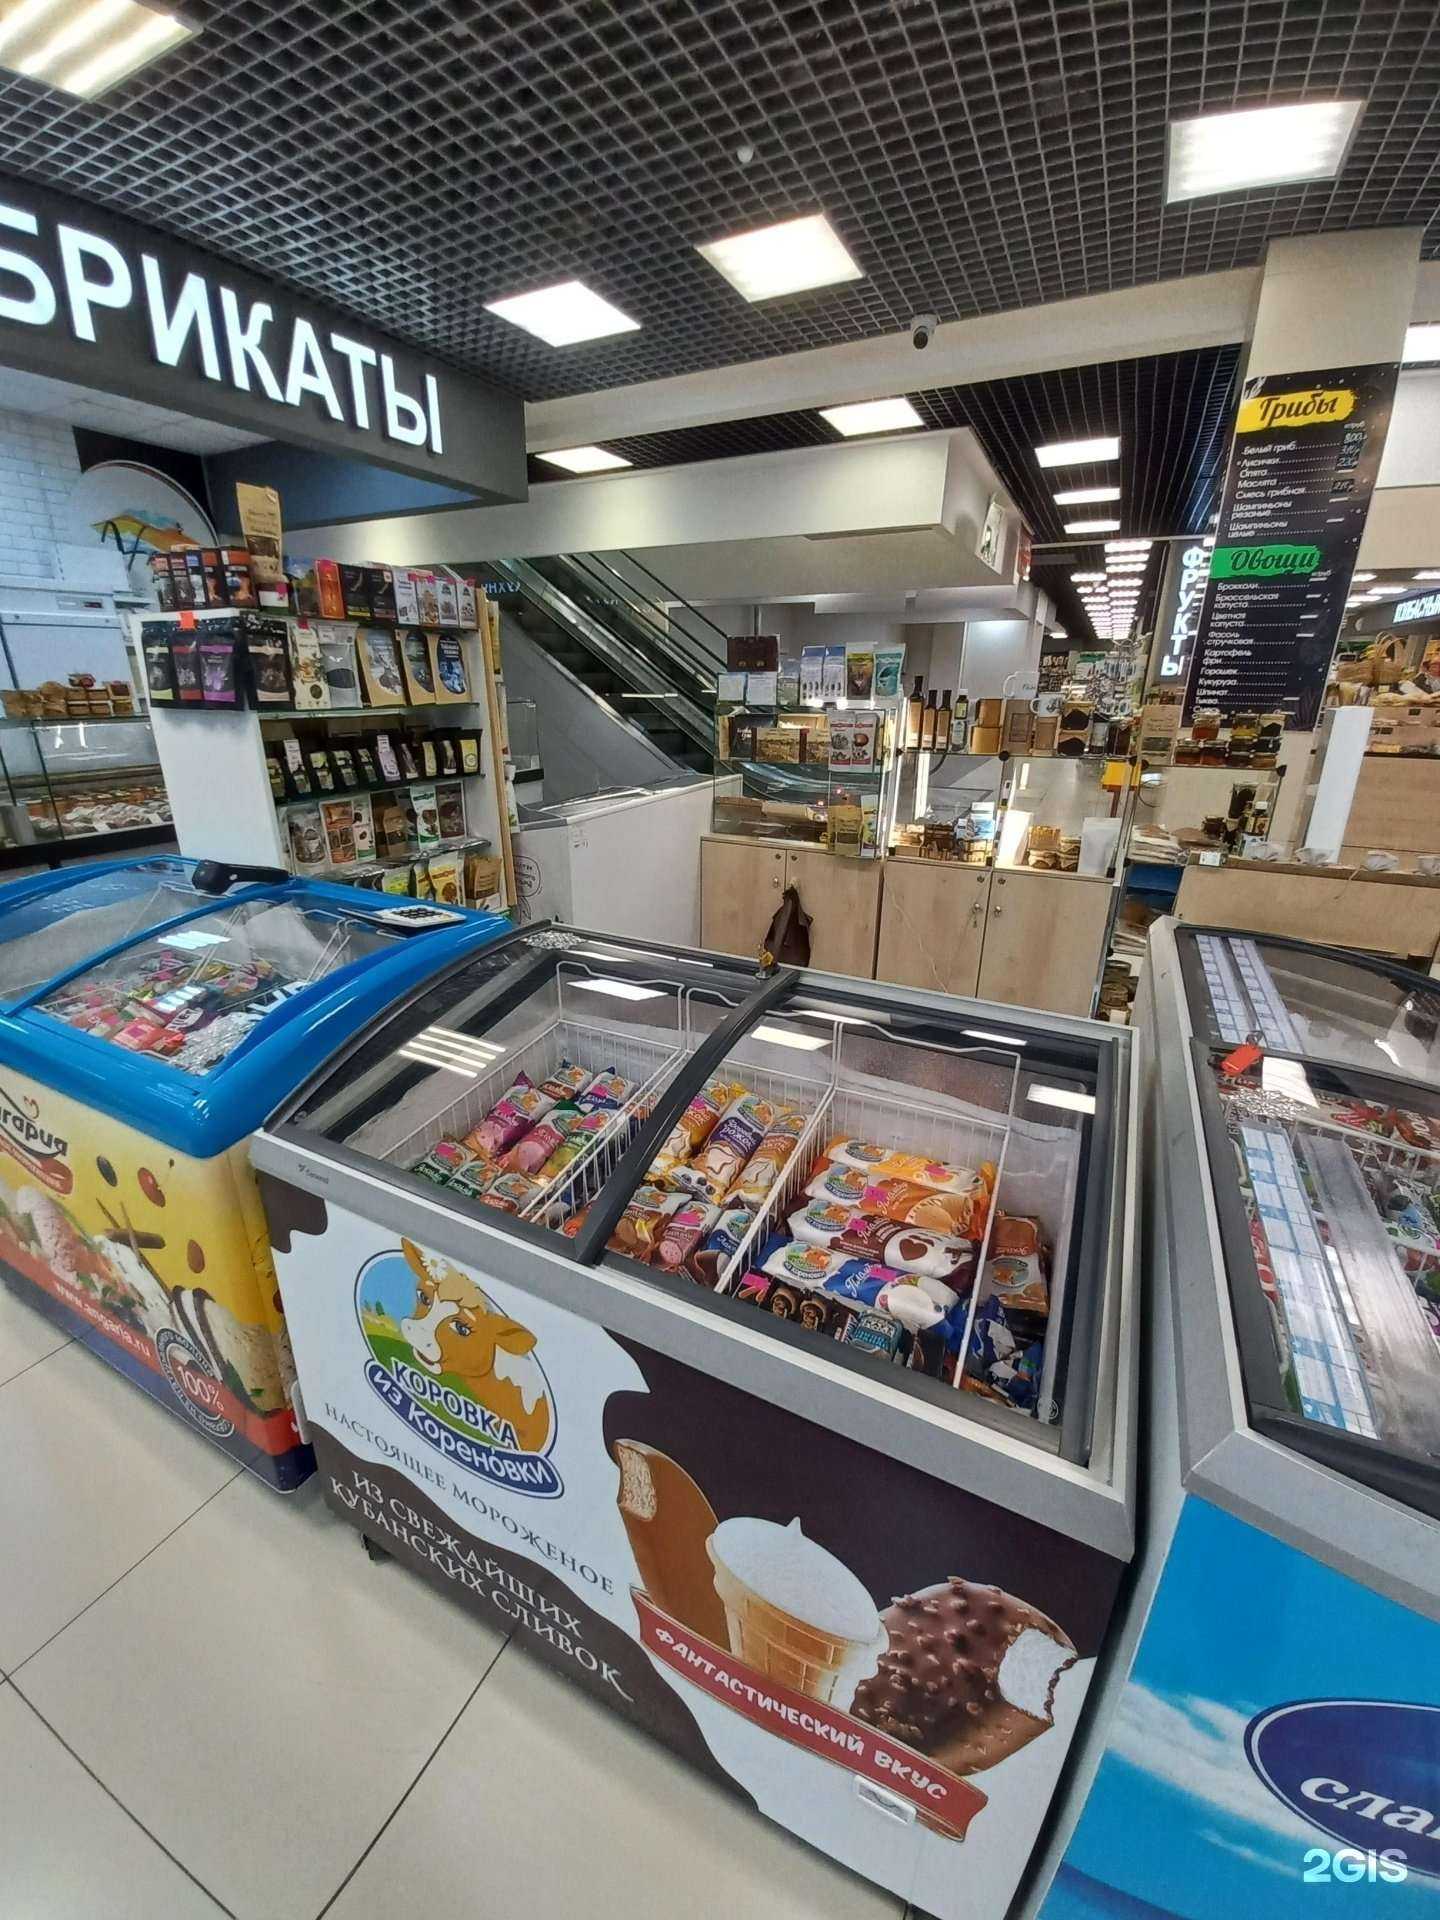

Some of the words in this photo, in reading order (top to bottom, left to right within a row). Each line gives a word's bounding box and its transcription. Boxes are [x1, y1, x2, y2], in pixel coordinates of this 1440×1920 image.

[1259, 392, 1339, 428] Грибы
[1243, 444, 1272, 455] Белый
[1273, 441, 1297, 453] гриб
[1240, 468, 1268, 478] Опята
[1238, 479, 1277, 488] Маслята
[1235, 491, 1265, 499] Смесь
[1267, 487, 1305, 498] грибная
[1233, 501, 1292, 511] Шампиньоны
[1229, 521, 1288, 531] Шампиньоны
[1230, 548, 1316, 575] Овощи
[1217, 583, 1258, 592] Брокколи
[1215, 593, 1279, 602] Брюссельская
[1161, 546, 1205, 676] ФРУКТЫ
[1214, 601, 1248, 610] капуста
[1208, 631, 1240, 639] Фасоль
[1203, 649, 1252, 658] Картофель
[1200, 667, 1239, 675] Горошек
[1198, 678, 1238, 686] Кукуруза
[0, 1106, 69, 1157] гария
[392, 1359, 519, 1450] КОРОВКА
[324, 1402, 448, 1491] НАСТОЯЩЕЕ
[452, 1485, 615, 1596] МОРОЖЕНОЕ
[351, 1470, 385, 1504] ИЗ
[389, 1498, 584, 1639] СВЕЖАЙШИХ
[329, 1477, 489, 1597] КУБАНСКИХ
[491, 1591, 635, 1703] СЛИВОК
[654, 1627, 865, 1757] ФАНТАСТИЧЕСКИЙ
[873, 1750, 948, 1800] ВКУС
[1300, 1777, 1440, 1840] сла
